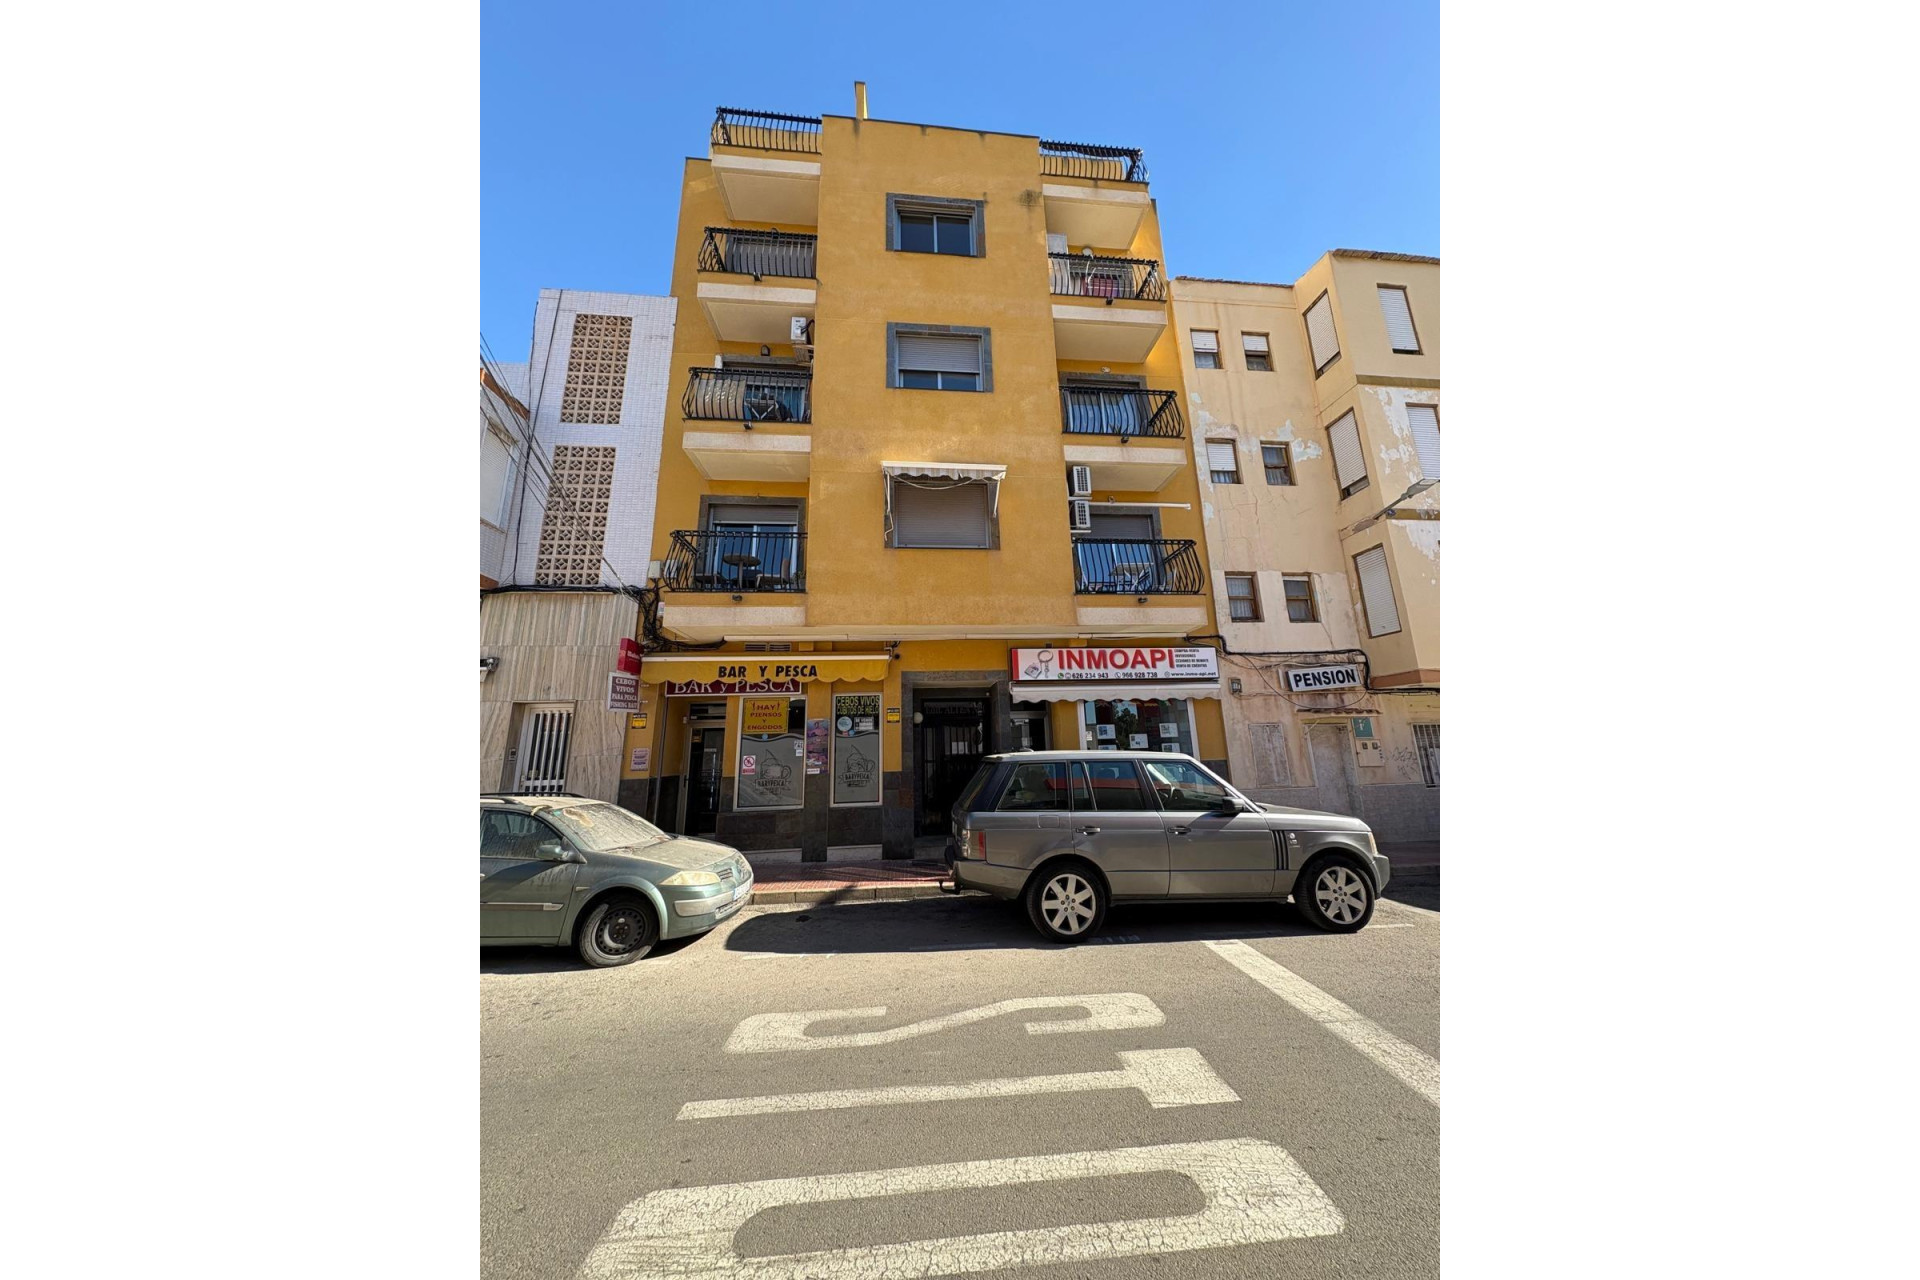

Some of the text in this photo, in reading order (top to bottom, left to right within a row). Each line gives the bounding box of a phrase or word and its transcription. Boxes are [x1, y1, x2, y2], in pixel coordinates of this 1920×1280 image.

[1058, 649, 1174, 669] INMOAPI
[718, 665, 818, 678] BAR Y PESCA
[1292, 668, 1357, 687] PENSION
[674, 681, 712, 693] BAR
[735, 680, 795, 692] PESCA
[836, 696, 880, 706] CEBOS VIVOS
